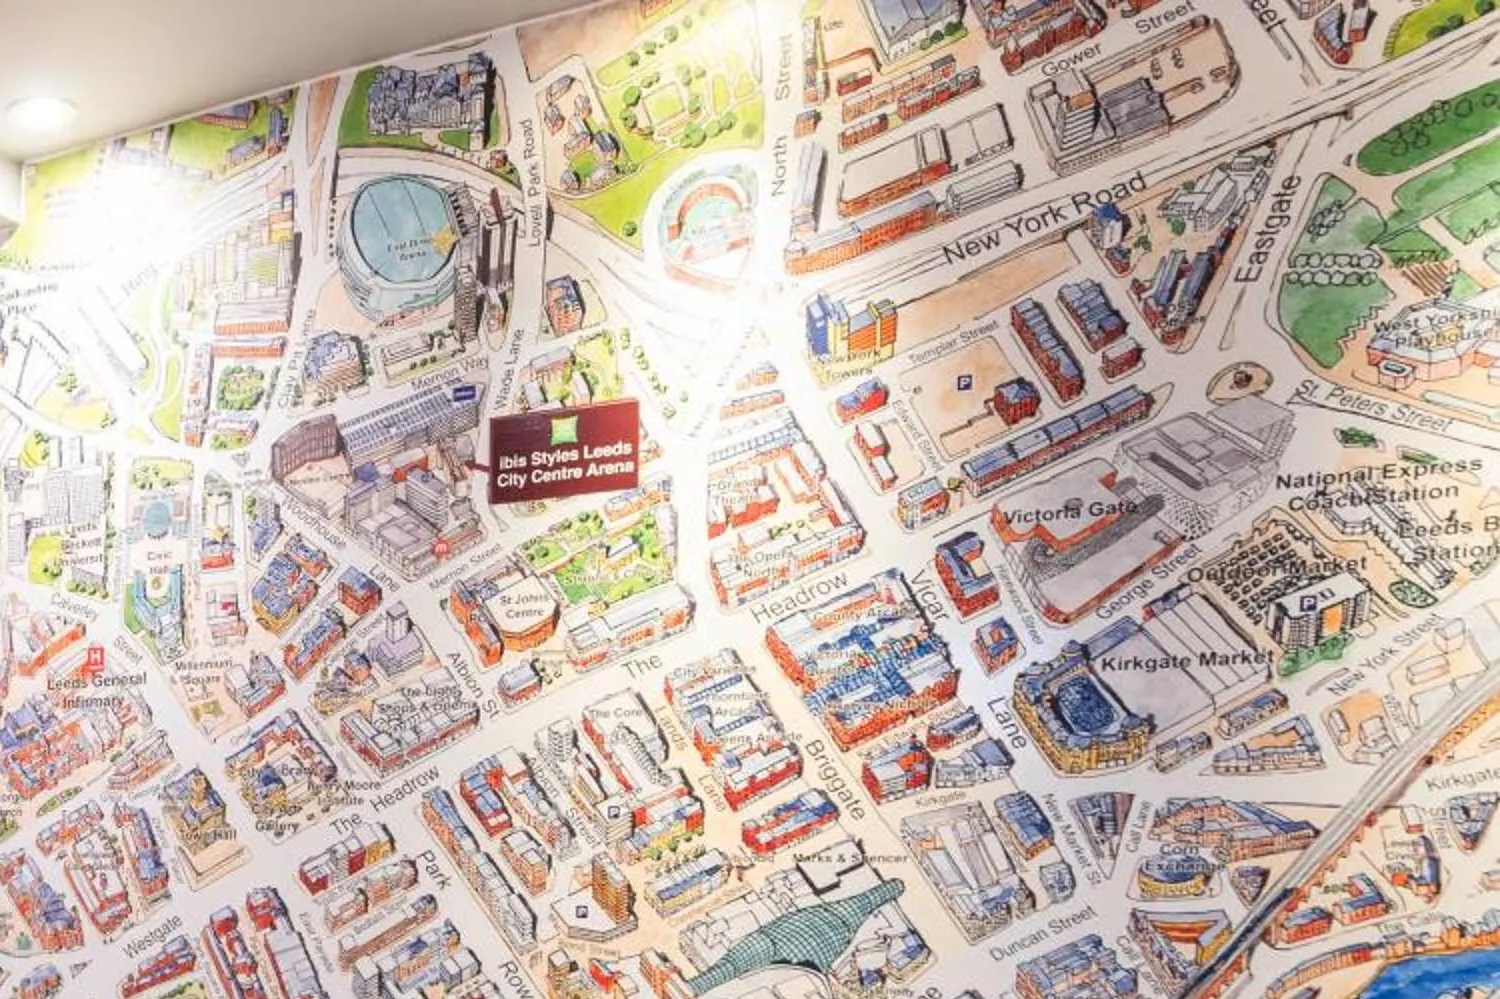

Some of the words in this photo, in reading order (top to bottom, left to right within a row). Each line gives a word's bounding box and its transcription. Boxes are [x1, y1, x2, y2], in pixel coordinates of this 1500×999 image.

[1041, 45, 1103, 77] Gower
[1135, 2, 1196, 35] Street
[522, 118, 535, 166] Road
[942, 230, 1001, 266] New
[1004, 203, 1067, 239] York
[1070, 170, 1148, 215] Road
[1235, 175, 1302, 284] Eastgate
[460, 354, 491, 377] Way
[1329, 386, 1388, 418] Peters
[1390, 401, 1454, 433] Street
[497, 472, 528, 490] City
[531, 466, 583, 485] Centre
[586, 459, 635, 478] Arena
[531, 448, 579, 468] Styles
[583, 440, 633, 459] Leeds
[1275, 466, 1373, 491] National
[1381, 459, 1484, 481] Express
[1003, 503, 1081, 527] Victoria
[1088, 500, 1140, 519] Gate
[1373, 485, 1460, 505] Station
[1399, 518, 1473, 539] Leeds
[370, 563, 400, 594] Lane
[751, 570, 849, 626] Headrow
[1095, 577, 1156, 621] George
[1151, 541, 1203, 581] Street
[621, 652, 664, 682] The
[911, 569, 949, 624] Vicar
[987, 697, 1028, 751] Lane
[1101, 655, 1192, 673] Kirkgate
[1198, 649, 1275, 669] Market
[1326, 670, 1367, 698] New
[1368, 645, 1399, 675] York
[1401, 612, 1446, 649] Street
[93, 671, 148, 689] General
[447, 650, 485, 699] Albion
[482, 698, 501, 721] St
[330, 811, 363, 836] The
[370, 765, 442, 814] Headrow
[804, 738, 866, 824] Briggate
[416, 848, 452, 892] Park
[1159, 843, 1200, 857] Corn
[121, 913, 185, 958] Westgate
[990, 926, 1049, 964] Duncan
[1050, 904, 1099, 937] Street
